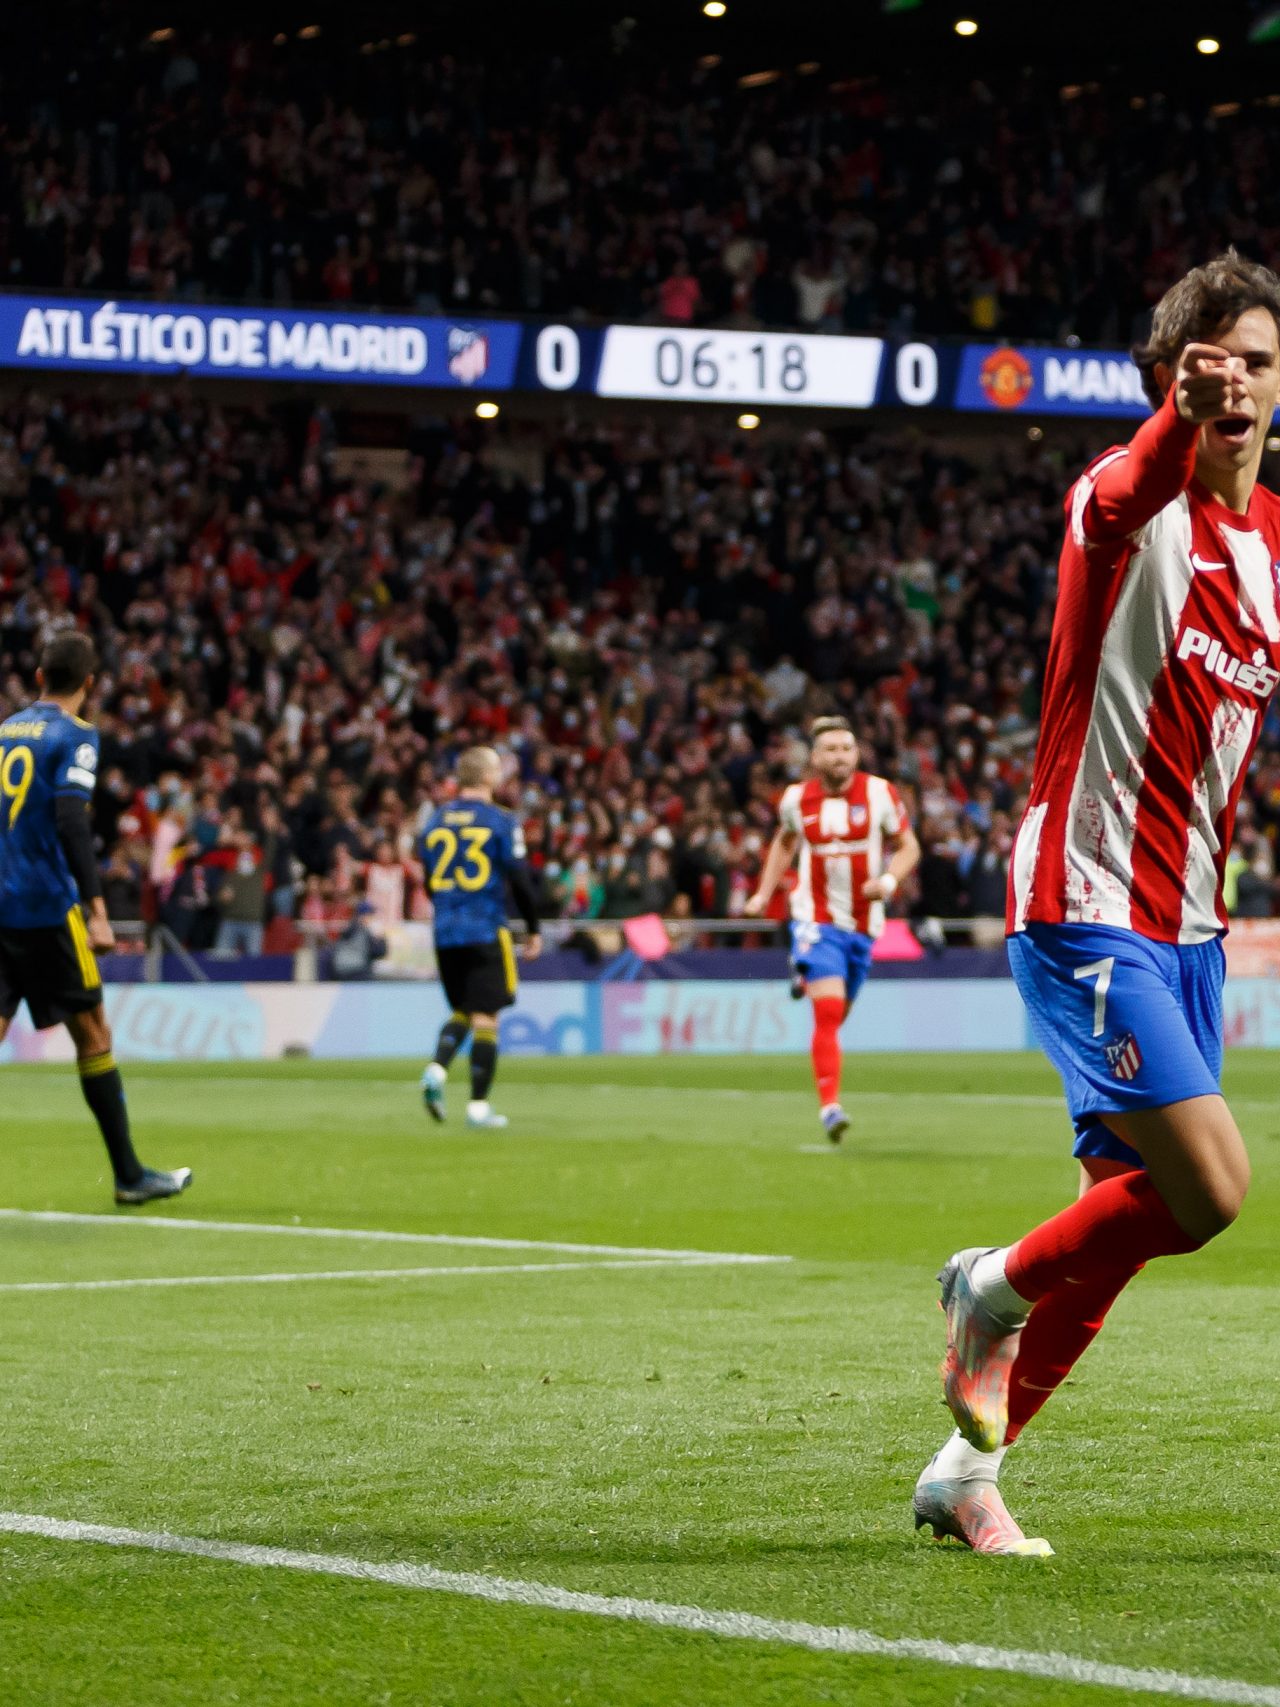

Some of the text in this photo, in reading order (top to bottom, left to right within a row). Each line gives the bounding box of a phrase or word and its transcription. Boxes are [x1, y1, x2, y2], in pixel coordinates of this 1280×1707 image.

[17, 302, 427, 375] ATLÉTICO DE MADRID
[536, 325, 580, 391] 0
[656, 337, 808, 393] 06:18
[896, 342, 938, 406] 0
[425, 827, 493, 892] 23
[1073, 956, 1116, 1038] 7
